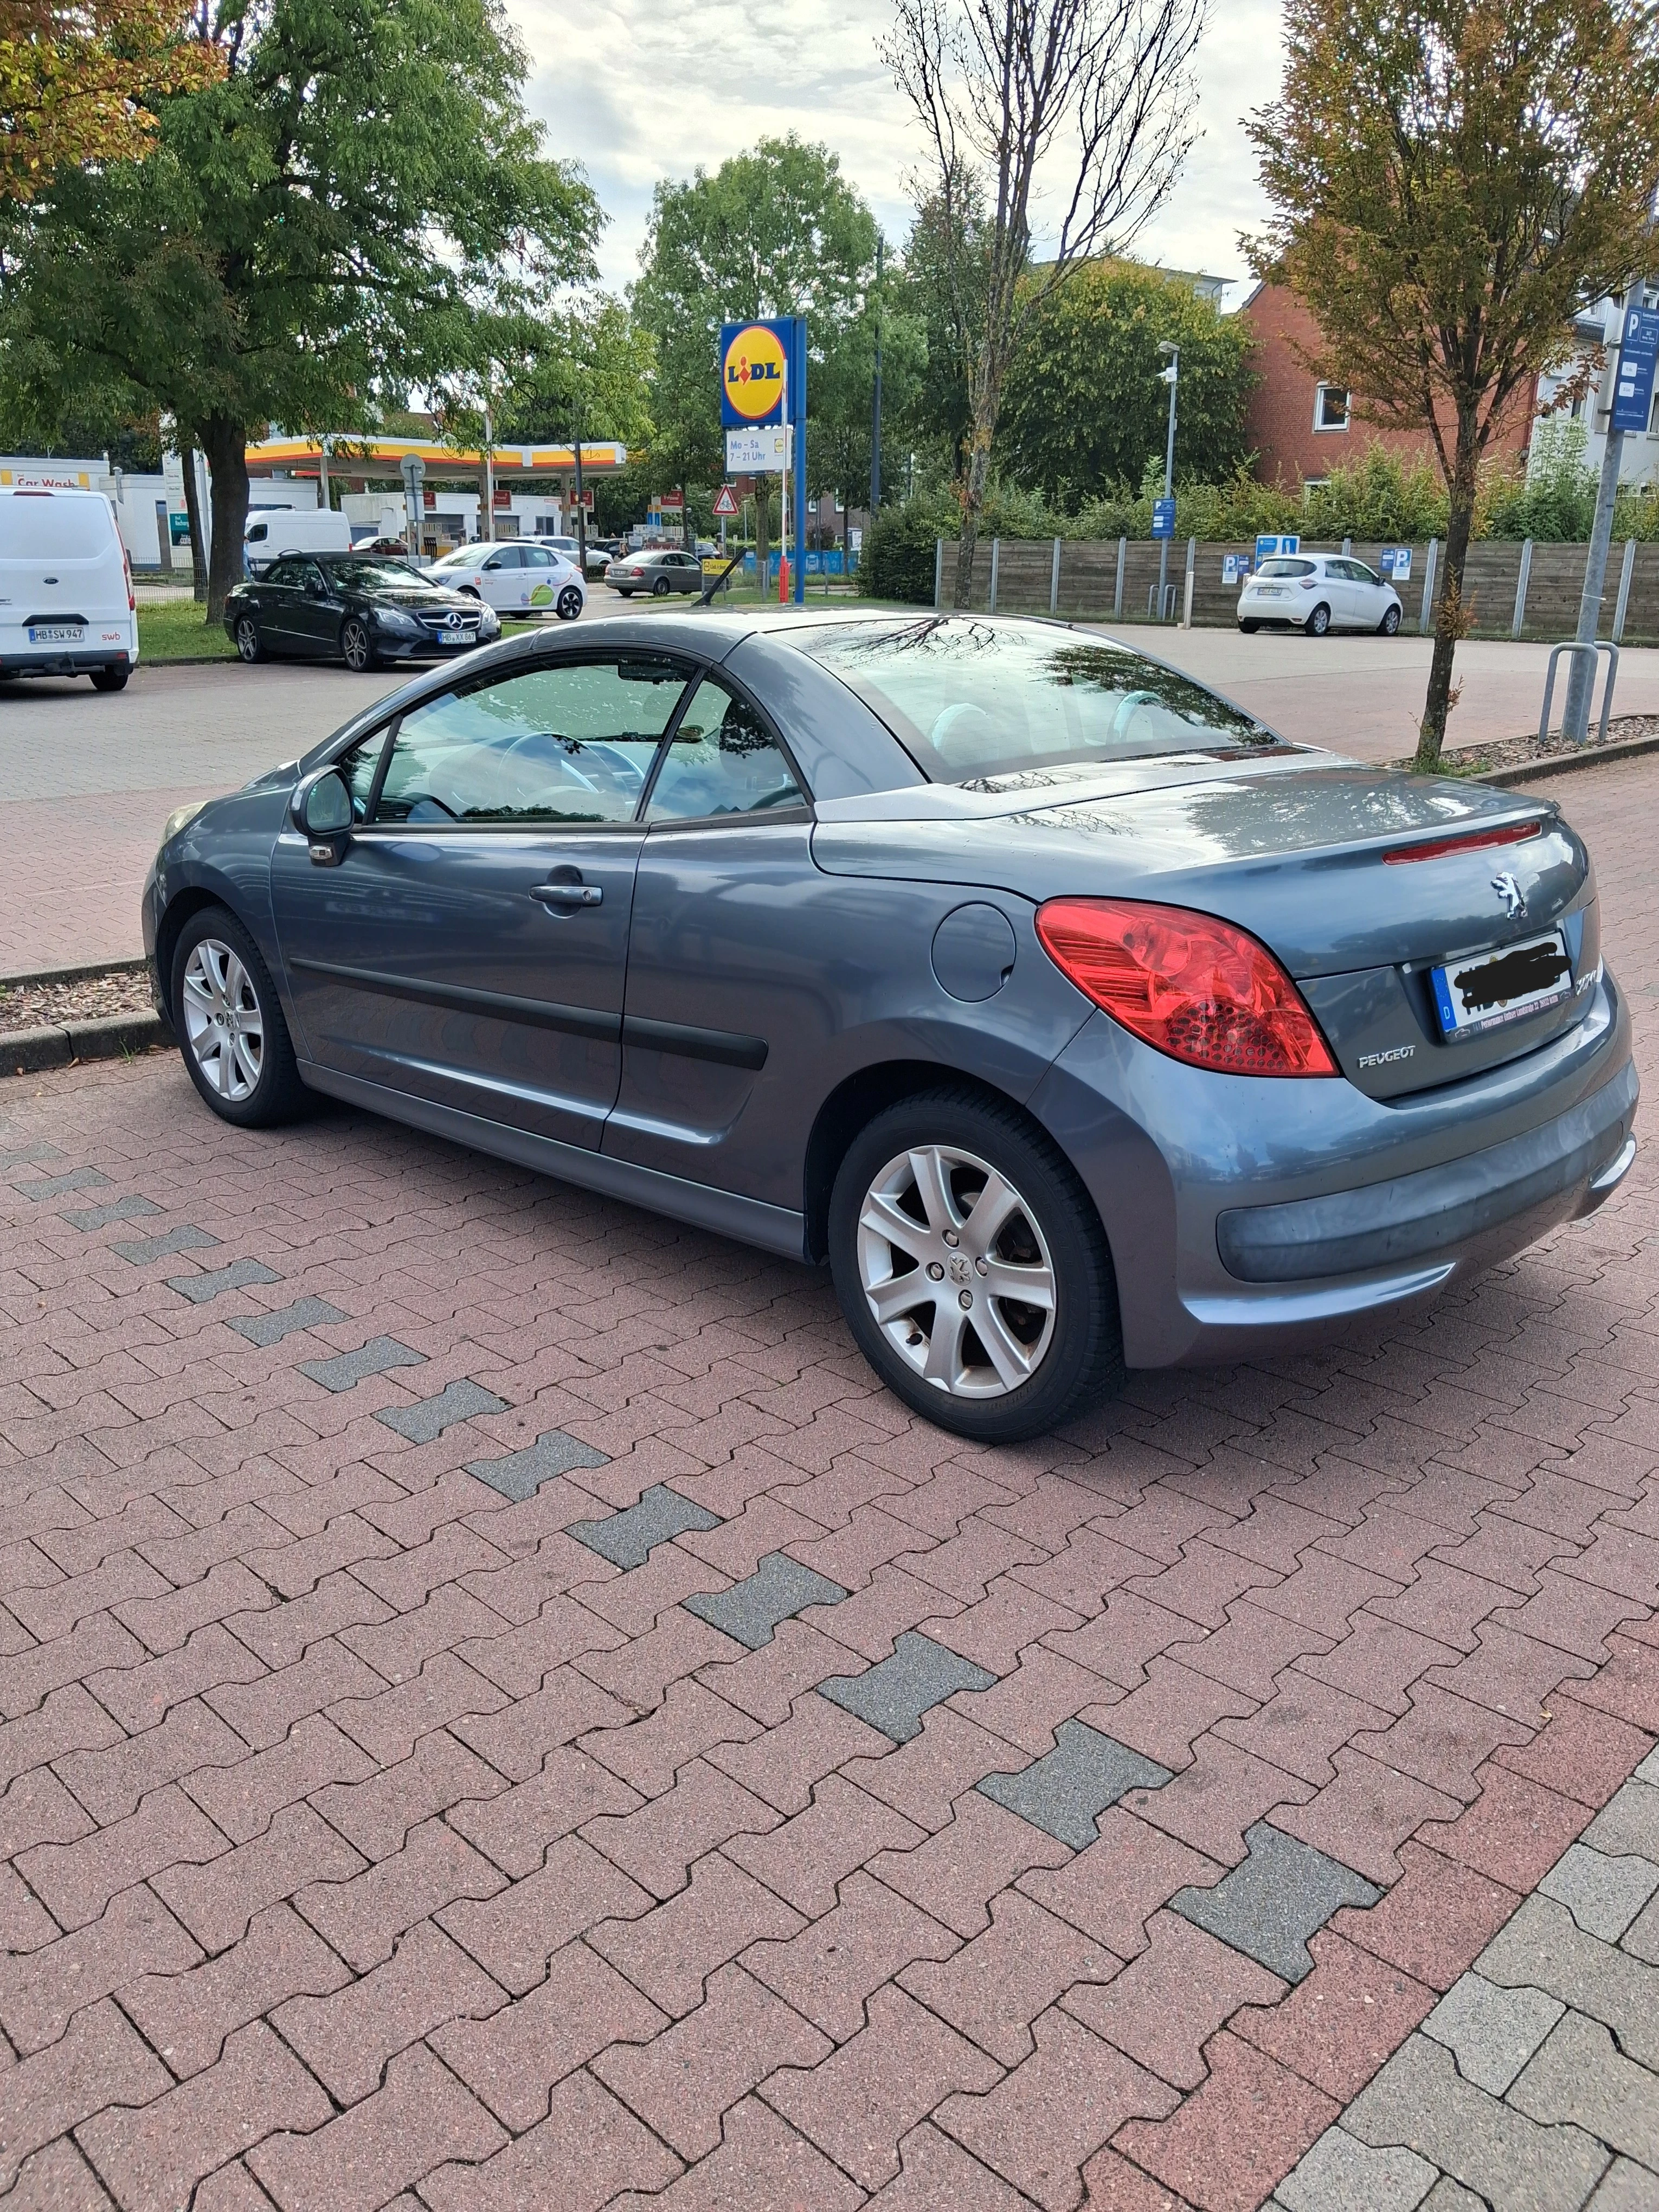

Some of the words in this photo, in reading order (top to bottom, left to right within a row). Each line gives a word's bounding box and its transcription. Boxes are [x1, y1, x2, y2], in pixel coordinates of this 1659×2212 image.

[1629, 314, 1639, 337] P
[730, 440, 742, 449] Mo
[750, 439, 759, 448] Sa
[730, 453, 734, 461] 7
[742, 452, 750, 461] 21
[752, 451, 766, 460] Uhr
[18, 478, 38, 486] Car
[41, 479, 75, 487] Wash
[36, 631, 48, 640] HB
[54, 630, 65, 639] SW
[66, 629, 82, 639] 947
[102, 632, 120, 640] swb
[1443, 1006, 1450, 1020] D
[1357, 1045, 1416, 1069] PEUGEOT
